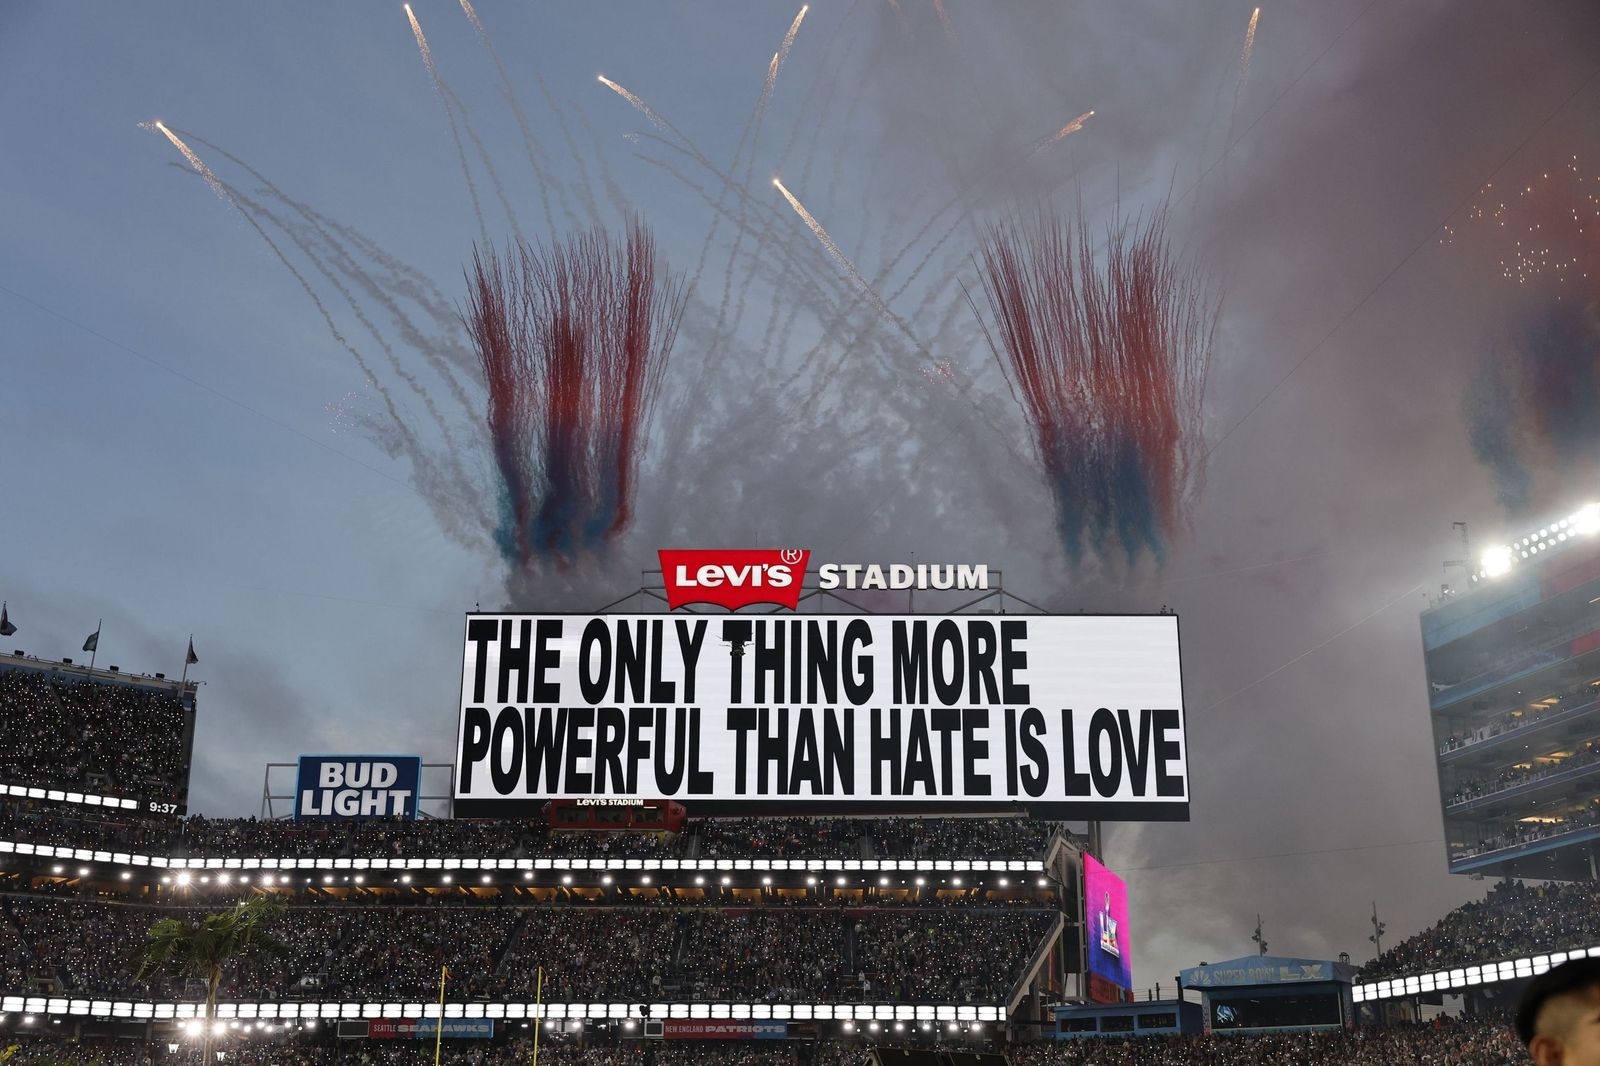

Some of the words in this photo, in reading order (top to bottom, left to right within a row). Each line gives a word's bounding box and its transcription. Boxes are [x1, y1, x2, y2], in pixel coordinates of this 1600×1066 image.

[818, 563, 989, 590] STADIUM
[468, 619, 563, 703] THE
[579, 618, 708, 705] ONLY
[723, 618, 874, 706] THING
[892, 619, 1030, 706] MORE
[459, 706, 713, 795] POWERFUL
[727, 708, 854, 795] THAN
[870, 708, 992, 796] HATE
[1004, 707, 1049, 797] IS
[1061, 707, 1184, 797] LOVE
[318, 762, 398, 788] BUD
[149, 801, 177, 814] 9:37
[300, 789, 411, 816] LIGHT
[1280, 964, 1323, 981] LX
[373, 1024, 397, 1032] SEATTLE
[665, 1025, 678, 1033] NEW
[679, 1025, 704, 1033] ENGLAND
[705, 1025, 786, 1033] PATRIOTS
